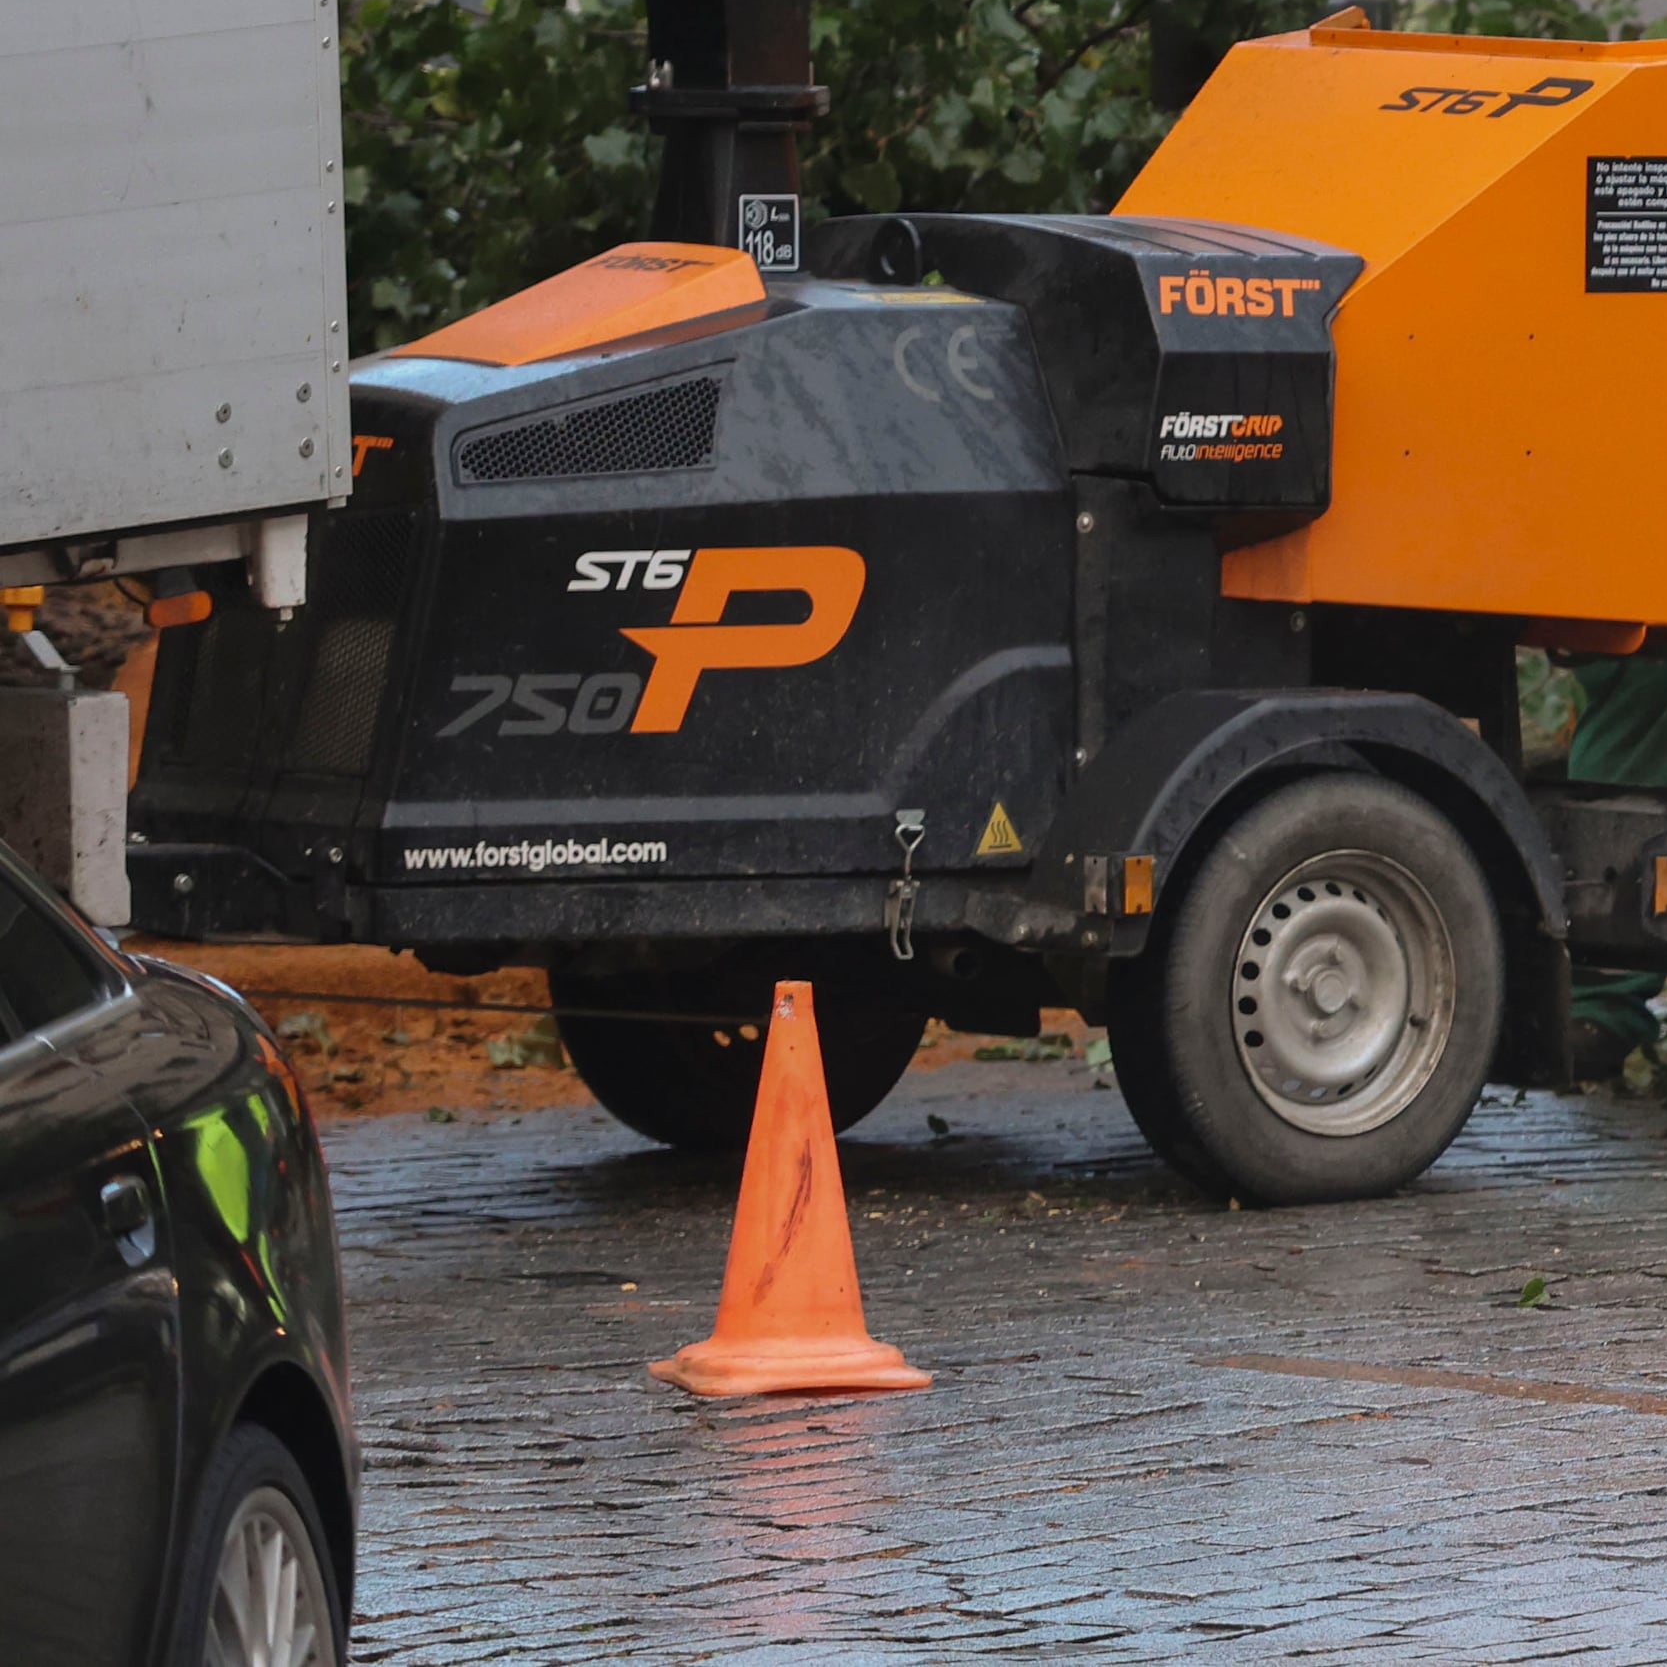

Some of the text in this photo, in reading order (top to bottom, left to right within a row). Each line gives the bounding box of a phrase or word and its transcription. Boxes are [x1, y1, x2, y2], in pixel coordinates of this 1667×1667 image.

[745, 229, 793, 266] 118 dB
[1159, 269, 1320, 318] FÖRST
[435, 672, 642, 737] 750
[404, 837, 667, 872] www.forstglobal.com
